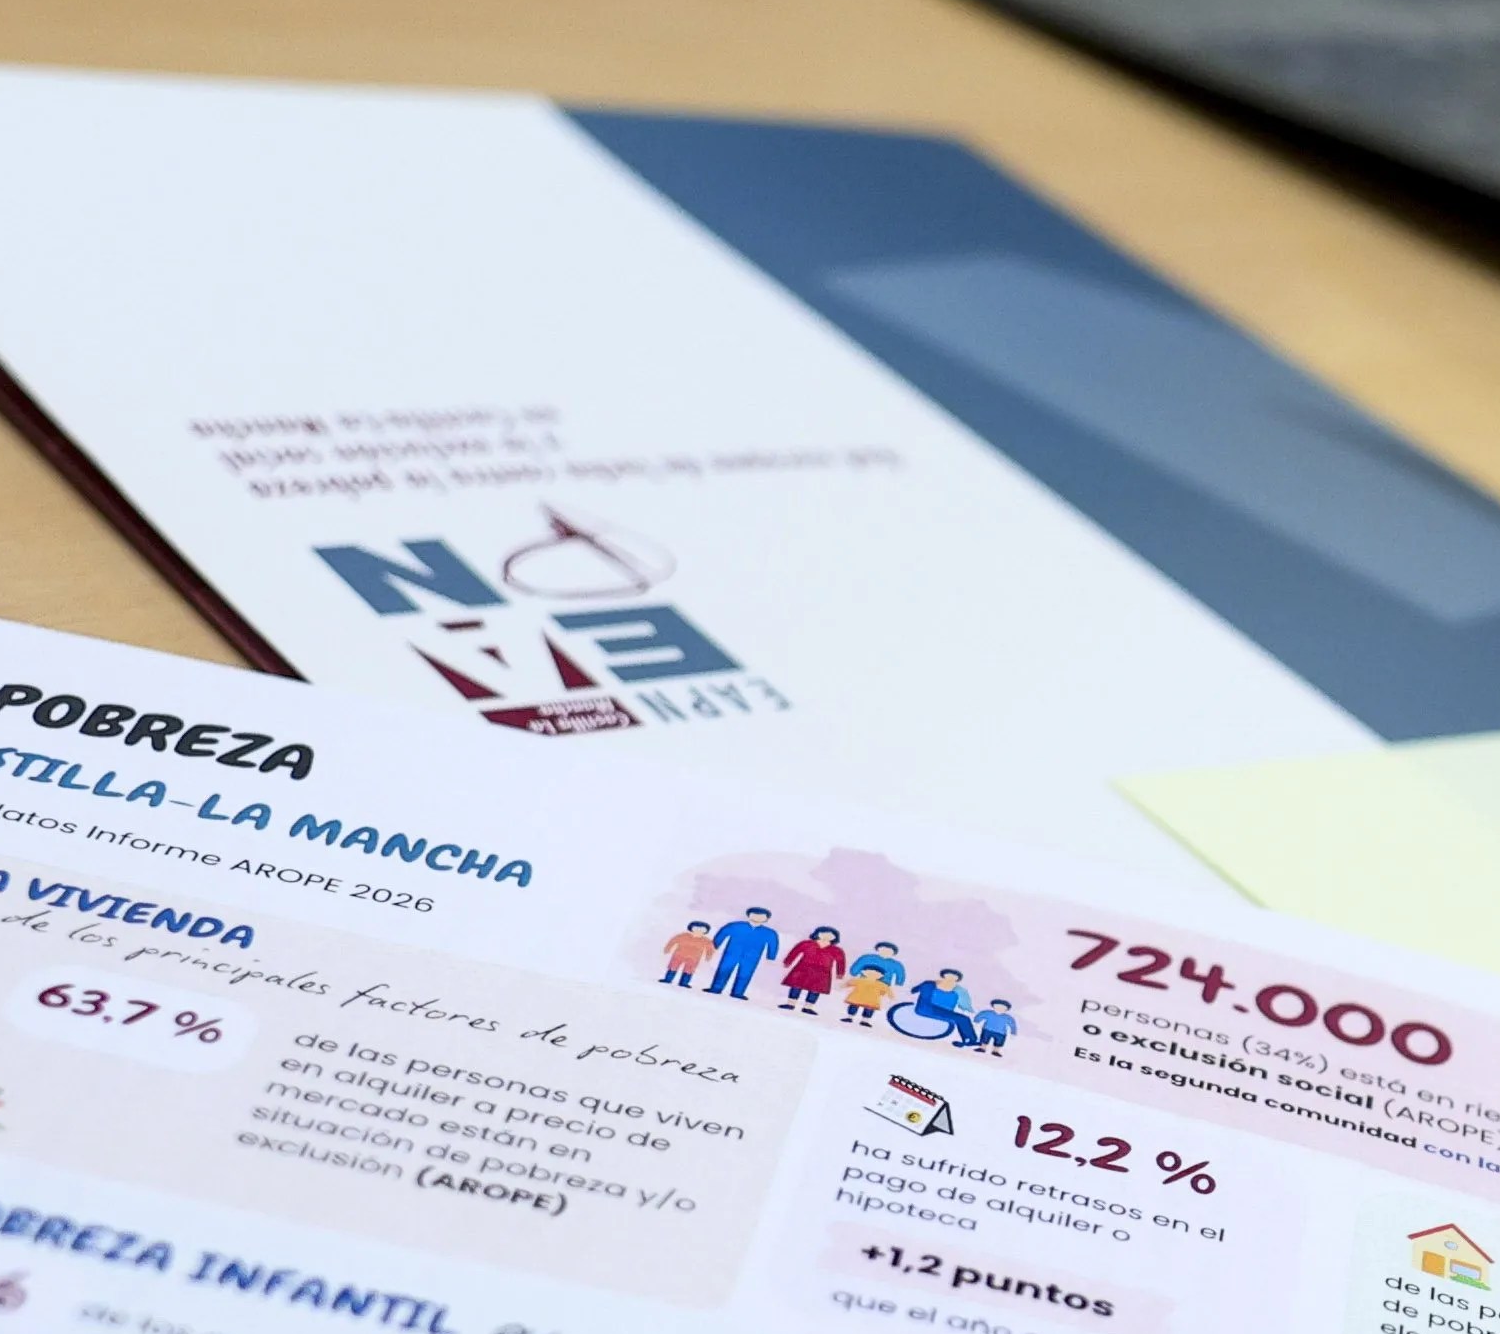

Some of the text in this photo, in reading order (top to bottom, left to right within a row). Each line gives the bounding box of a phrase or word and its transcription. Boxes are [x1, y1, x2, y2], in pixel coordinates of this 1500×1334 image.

[638, 677, 792, 722] EAPN
[85, 825, 222, 866] Informe
[229, 858, 343, 894] AROPE
[348, 883, 435, 913] 2026
[288, 813, 533, 888] MANCHA
[27, 877, 255, 950] VIVIENDA
[0, 909, 53, 933] de
[67, 922, 118, 948] los
[123, 946, 331, 996] principales
[339, 983, 501, 1032] factores
[519, 1023, 568, 1048] de
[575, 1043, 741, 1084] pobreza
[174, 1010, 222, 1044] %
[1067, 929, 1453, 1067] 724.000
[294, 1034, 745, 1140] de las personas que viven
[1080, 998, 1230, 1046] personas
[1241, 1034, 1329, 1075] (34%)
[1339, 1067, 1407, 1096] está
[1416, 1089, 1455, 1110] en
[1083, 1022, 1101, 1037] o
[1110, 1027, 1270, 1079] exclusión
[1278, 1074, 1373, 1109] social
[265, 1081, 592, 1164] mercado están en
[279, 1058, 671, 1152] en alquiler a precio de
[1073, 1046, 1101, 1063] Es
[1108, 1054, 1134, 1071] la
[1139, 1065, 1258, 1104] segunda
[1263, 1098, 1418, 1149] comunidad
[1423, 1144, 1471, 1165] con
[1478, 1156, 1500, 1173] la
[237, 1132, 568, 1217] exclusión (AROPE)
[251, 1106, 697, 1213] situación de pobreza y/o
[851, 1139, 1226, 1243] ha sufrido retrasos en el
[1014, 1114, 1217, 1195] 12,2 %
[835, 1186, 978, 1232] hipoteca
[841, 1166, 1131, 1242] pago de alquiler o
[831, 1290, 898, 1315] que
[906, 1306, 938, 1325] el
[861, 1245, 1114, 1317] +1,2 puntos
[1382, 1299, 1419, 1319] de
[1384, 1276, 1421, 1296] de
[1429, 1286, 1469, 1311] las
